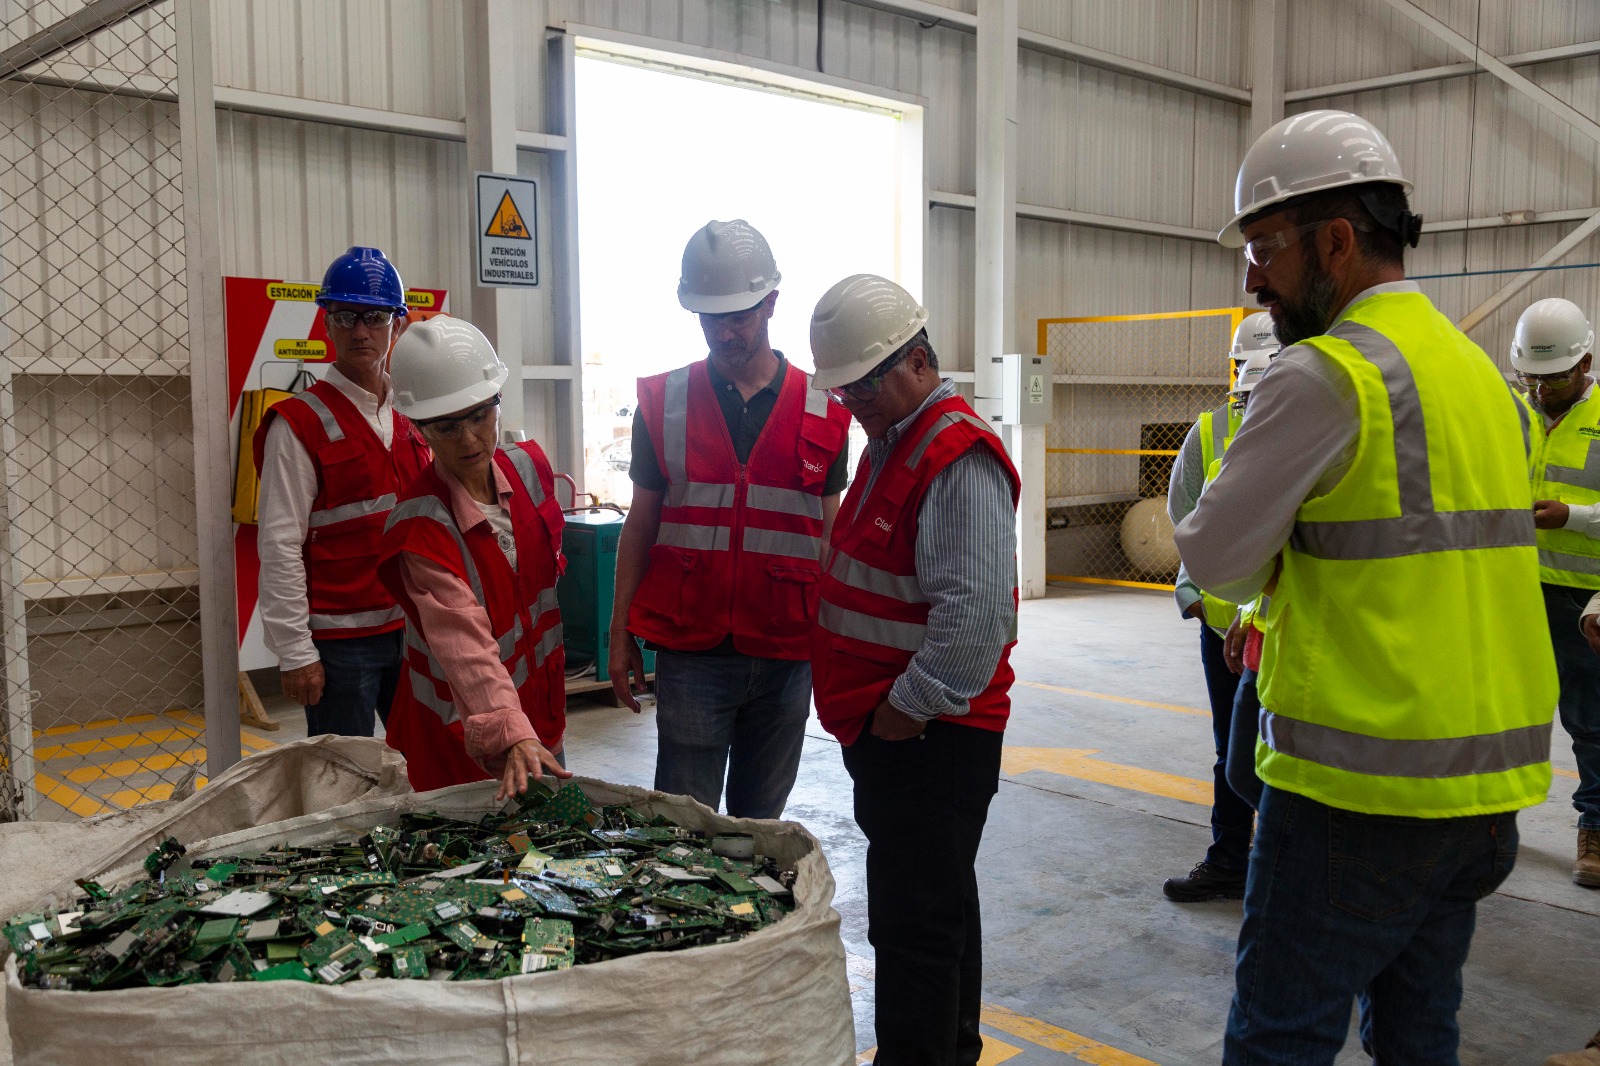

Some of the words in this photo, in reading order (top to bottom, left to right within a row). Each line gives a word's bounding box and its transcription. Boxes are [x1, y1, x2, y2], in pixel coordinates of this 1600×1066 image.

[491, 246, 526, 257] ATENCIÓN
[490, 257, 529, 269] VEHÍCULOS
[484, 269, 534, 280] INDUSTRIALES
[270, 287, 313, 299] ESTACIÓN
[278, 348, 326, 356] ANTIDERRAME
